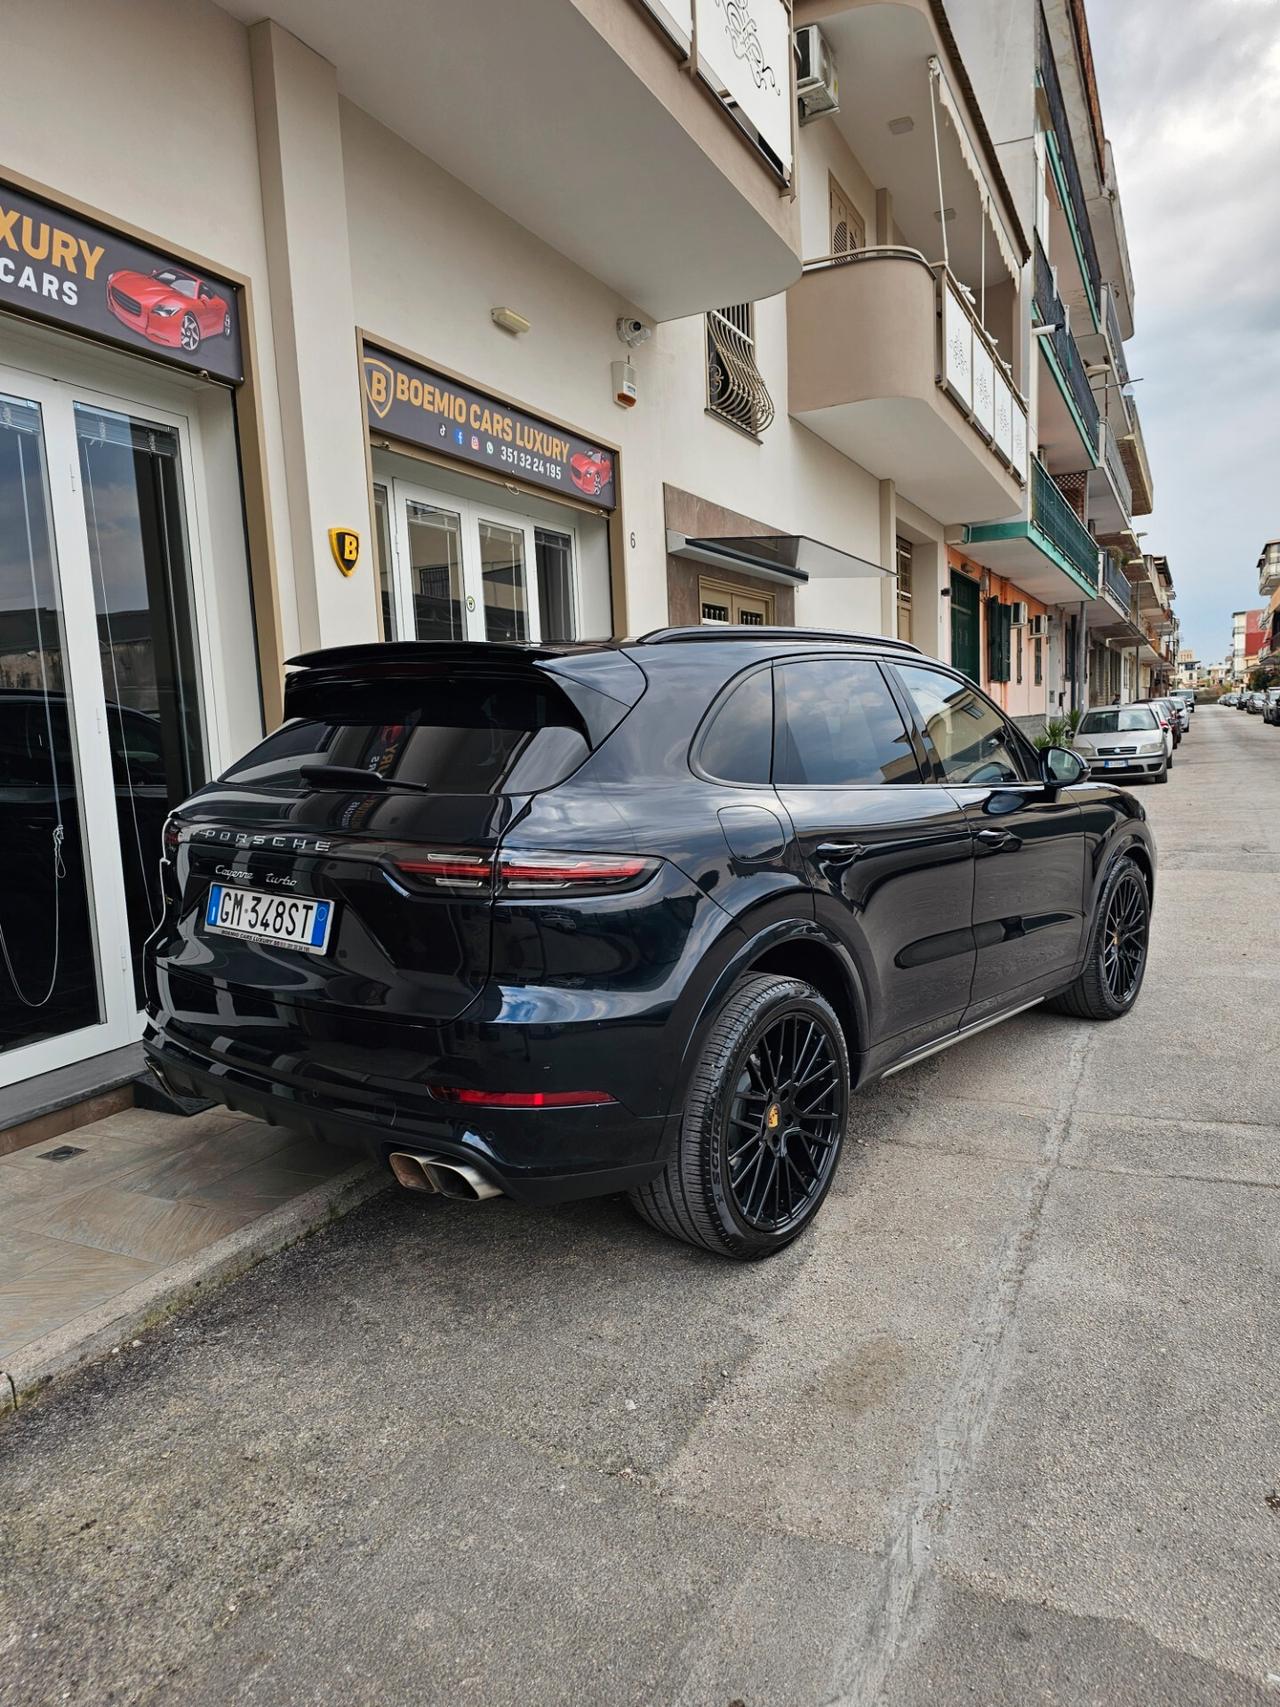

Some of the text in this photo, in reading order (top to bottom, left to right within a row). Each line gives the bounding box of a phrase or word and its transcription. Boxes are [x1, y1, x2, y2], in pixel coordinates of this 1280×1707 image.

[0, 257, 78, 306] CARS
[371, 369, 387, 403] B
[396, 372, 570, 463] BOEMIO CARS LUXURY
[500, 445, 562, 480] 351 32 24 195
[344, 534, 358, 561] B
[630, 531, 636, 549] 6
[203, 828, 331, 852] PORSCHE
[215, 864, 298, 886] Cayenne Turbo
